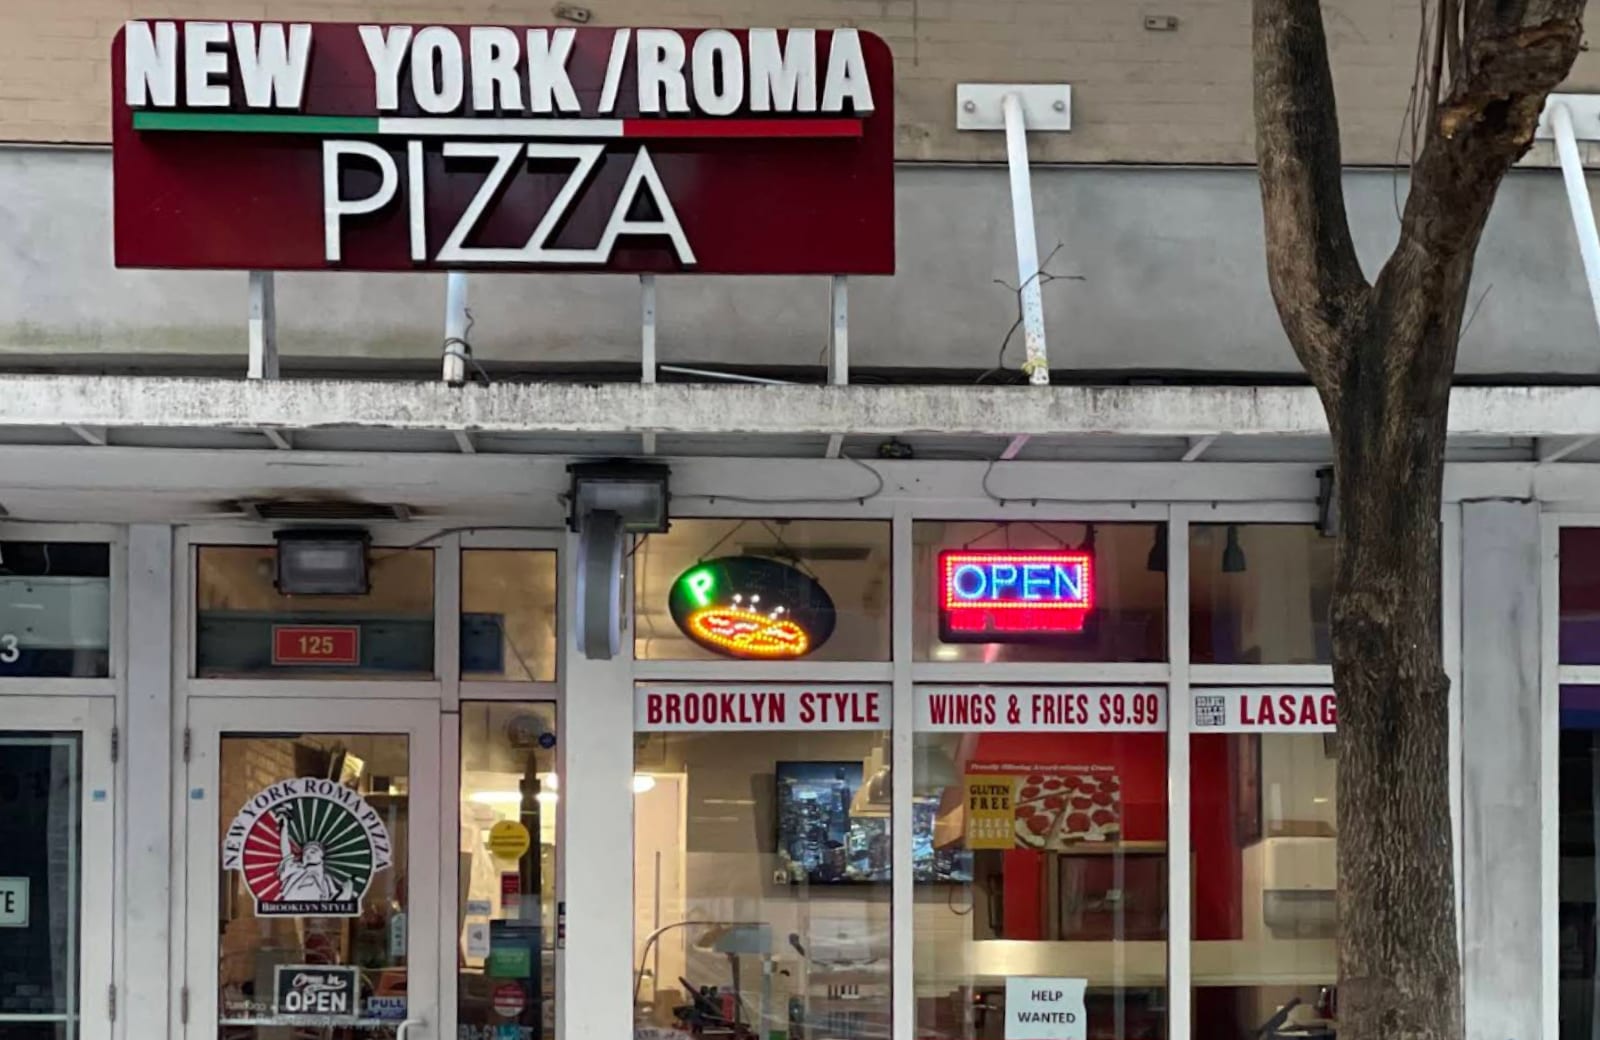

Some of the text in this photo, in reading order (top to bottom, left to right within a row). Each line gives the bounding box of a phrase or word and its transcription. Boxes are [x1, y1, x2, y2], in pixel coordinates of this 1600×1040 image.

[124, 20, 311, 108] NEW
[359, 26, 580, 113] YORK
[322, 139, 697, 265] PIZZA
[953, 563, 1083, 601] OPEN
[298, 636, 334, 655] 125
[647, 692, 880, 724] BROOKLYN STYLE
[929, 692, 1158, 726] WINGS & FRIES $9.99
[970, 784, 1010, 796] GLUTEN
[970, 797, 1009, 810] FREE
[225, 779, 390, 869] NEW YORK ROMA PIZZA
[261, 901, 355, 912] BROOKLYN STYLE
[285, 991, 347, 1012] OPEN
[370, 998, 403, 1008] PULL
[1031, 990, 1063, 1002] HELP
[1017, 1011, 1076, 1024] WANTED
